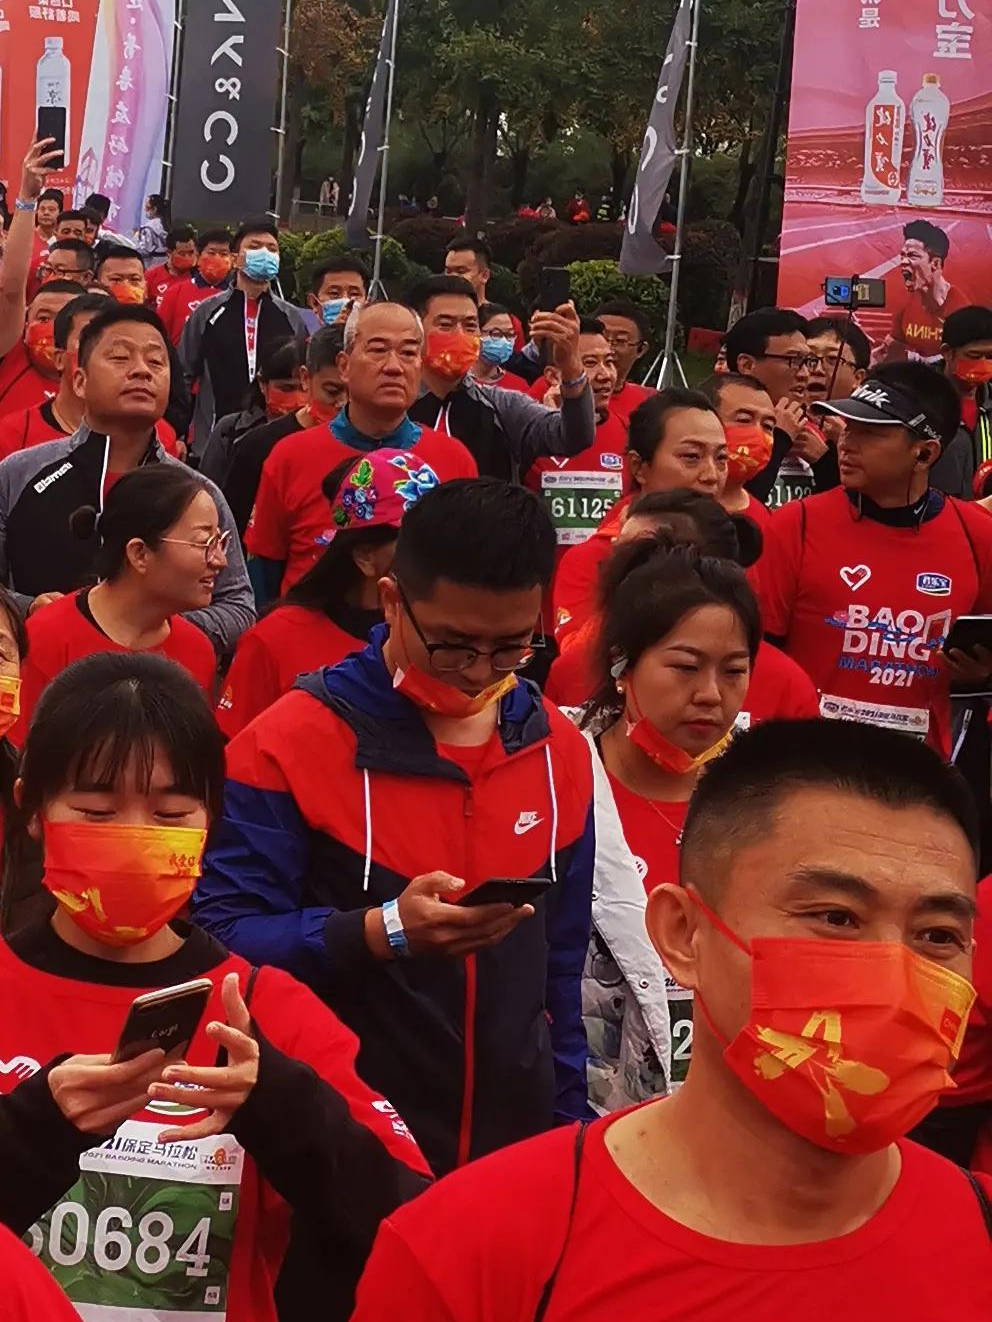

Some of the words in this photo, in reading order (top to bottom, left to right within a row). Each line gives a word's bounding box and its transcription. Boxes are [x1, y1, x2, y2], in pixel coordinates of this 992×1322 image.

[846, 604, 925, 634] BAO
[842, 630, 931, 662] DING
[870, 666, 915, 687] 2021
